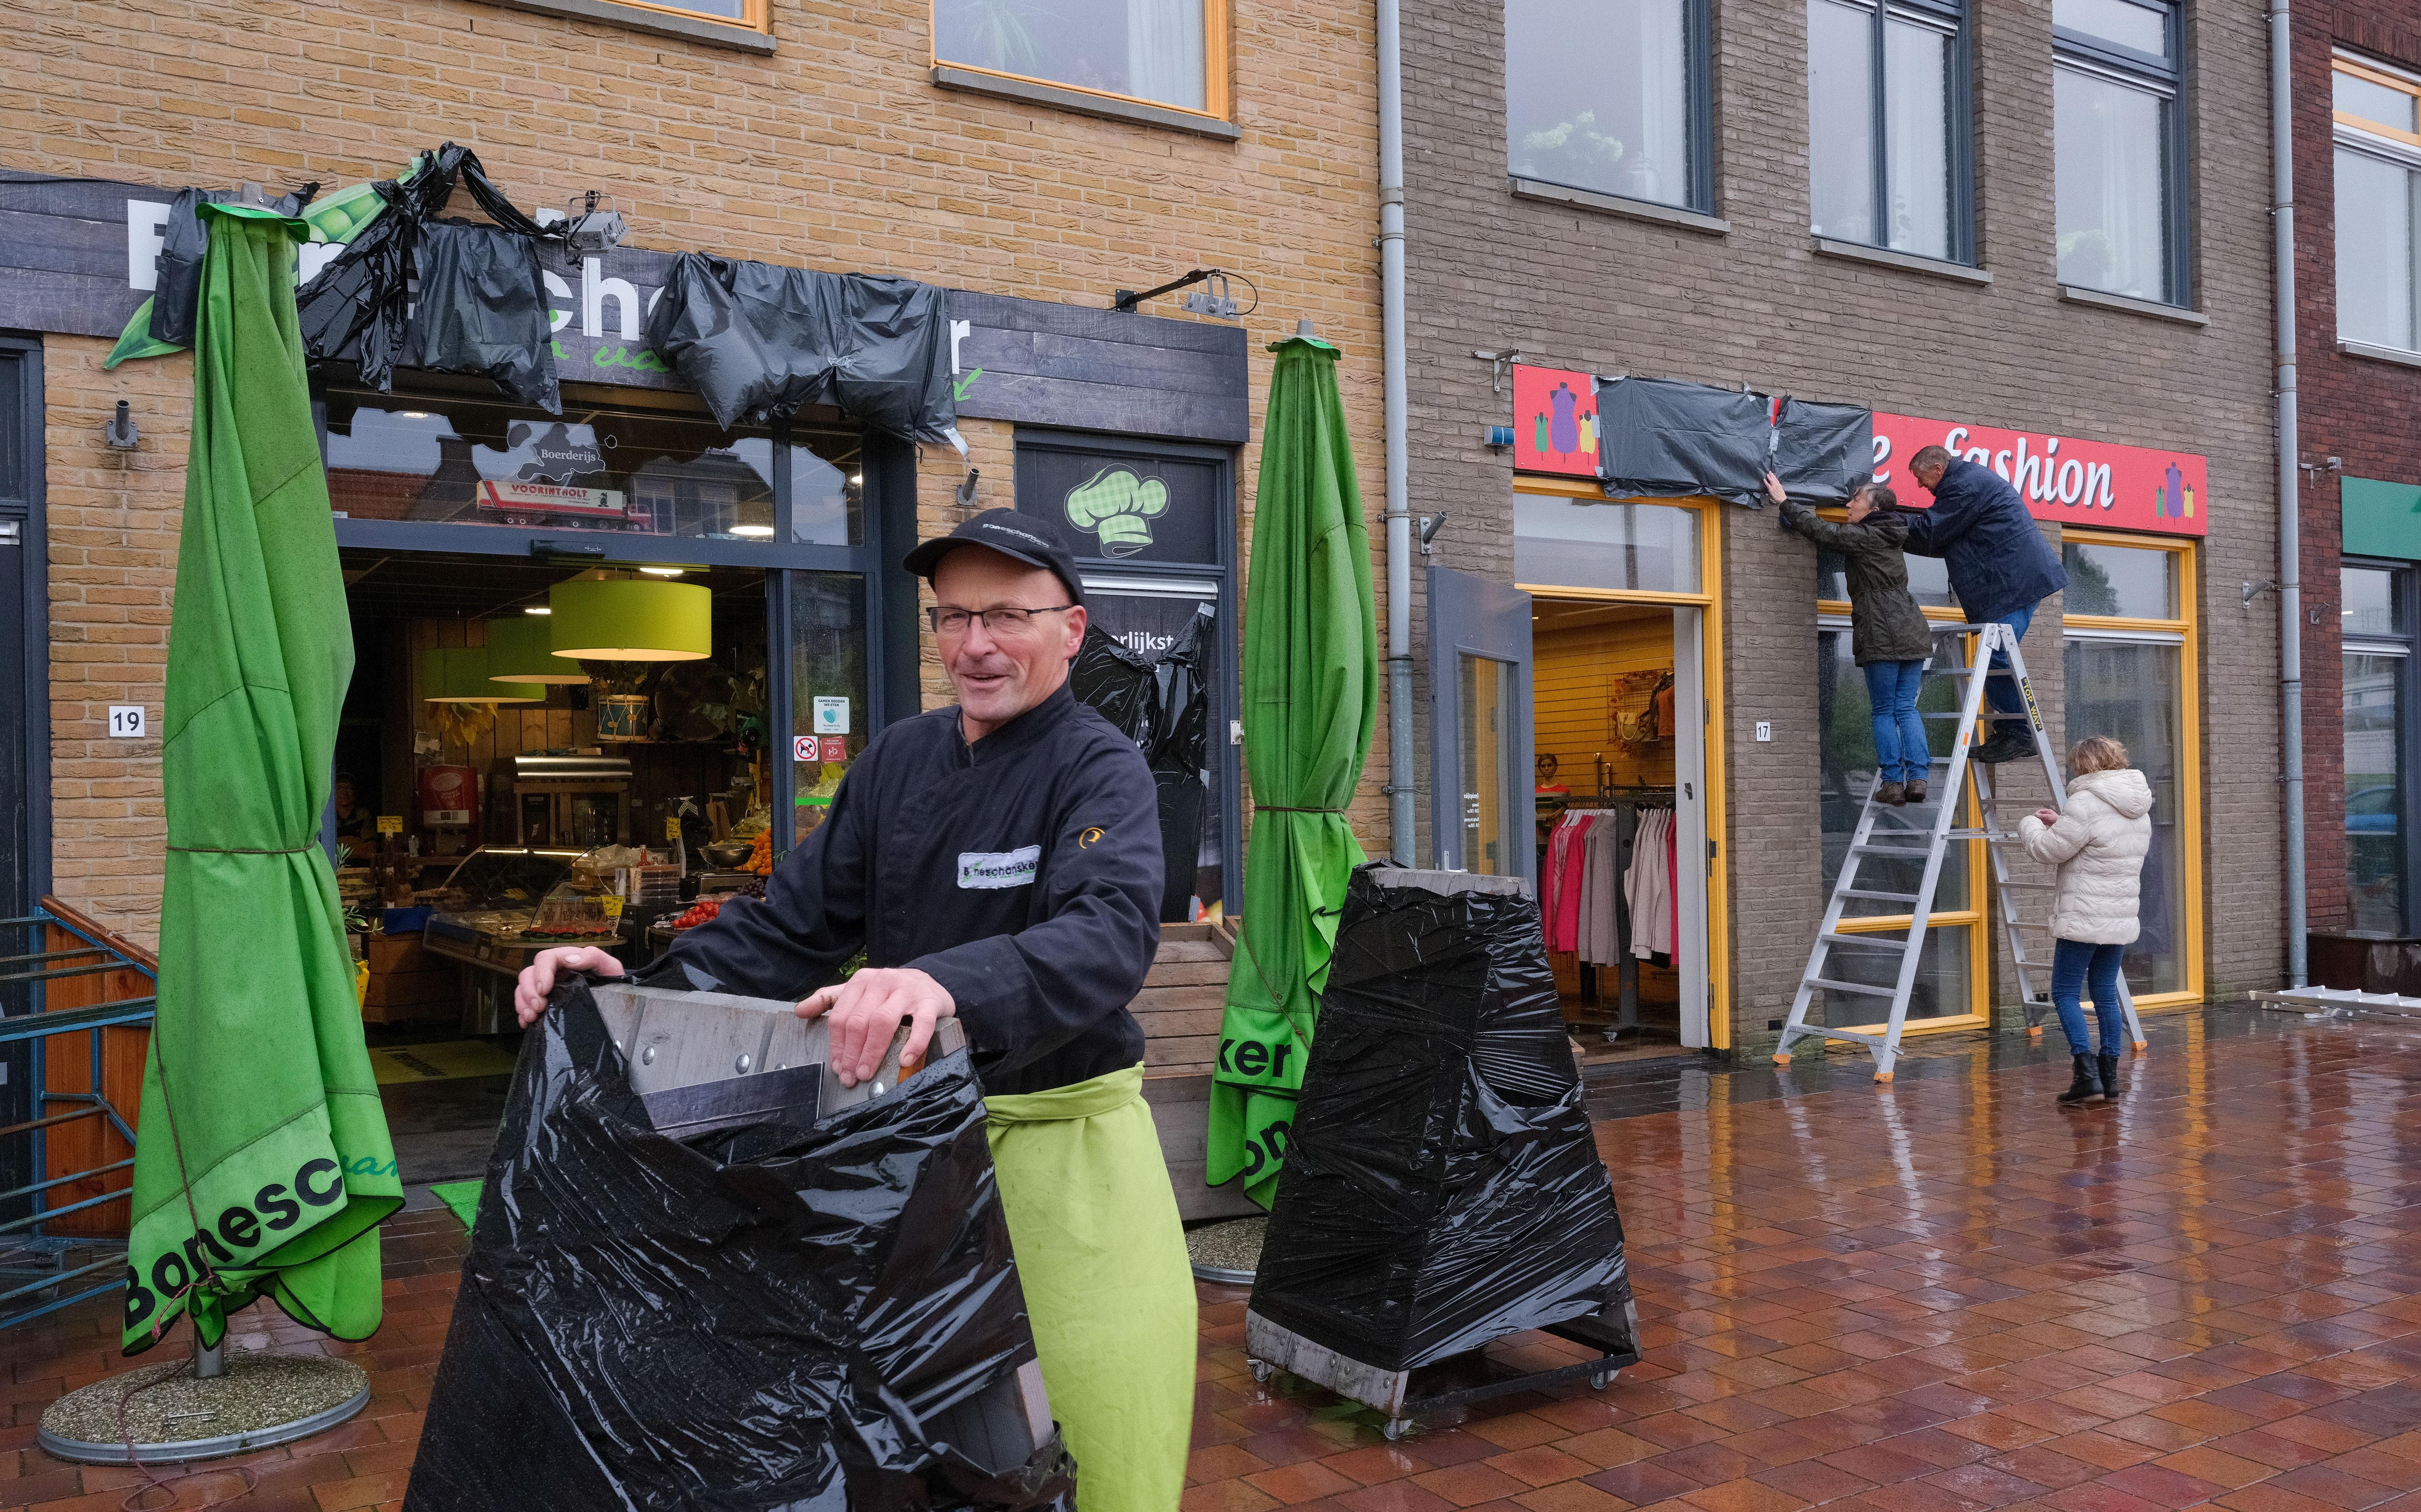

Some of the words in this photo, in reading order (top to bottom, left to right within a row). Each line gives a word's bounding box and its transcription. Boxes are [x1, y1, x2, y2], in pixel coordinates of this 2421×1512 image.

[541, 449, 596, 463] Boerderijs
[511, 484, 587, 498] VOORINTHOLT
[114, 712, 139, 731] 19
[1758, 726, 1768, 738] 17
